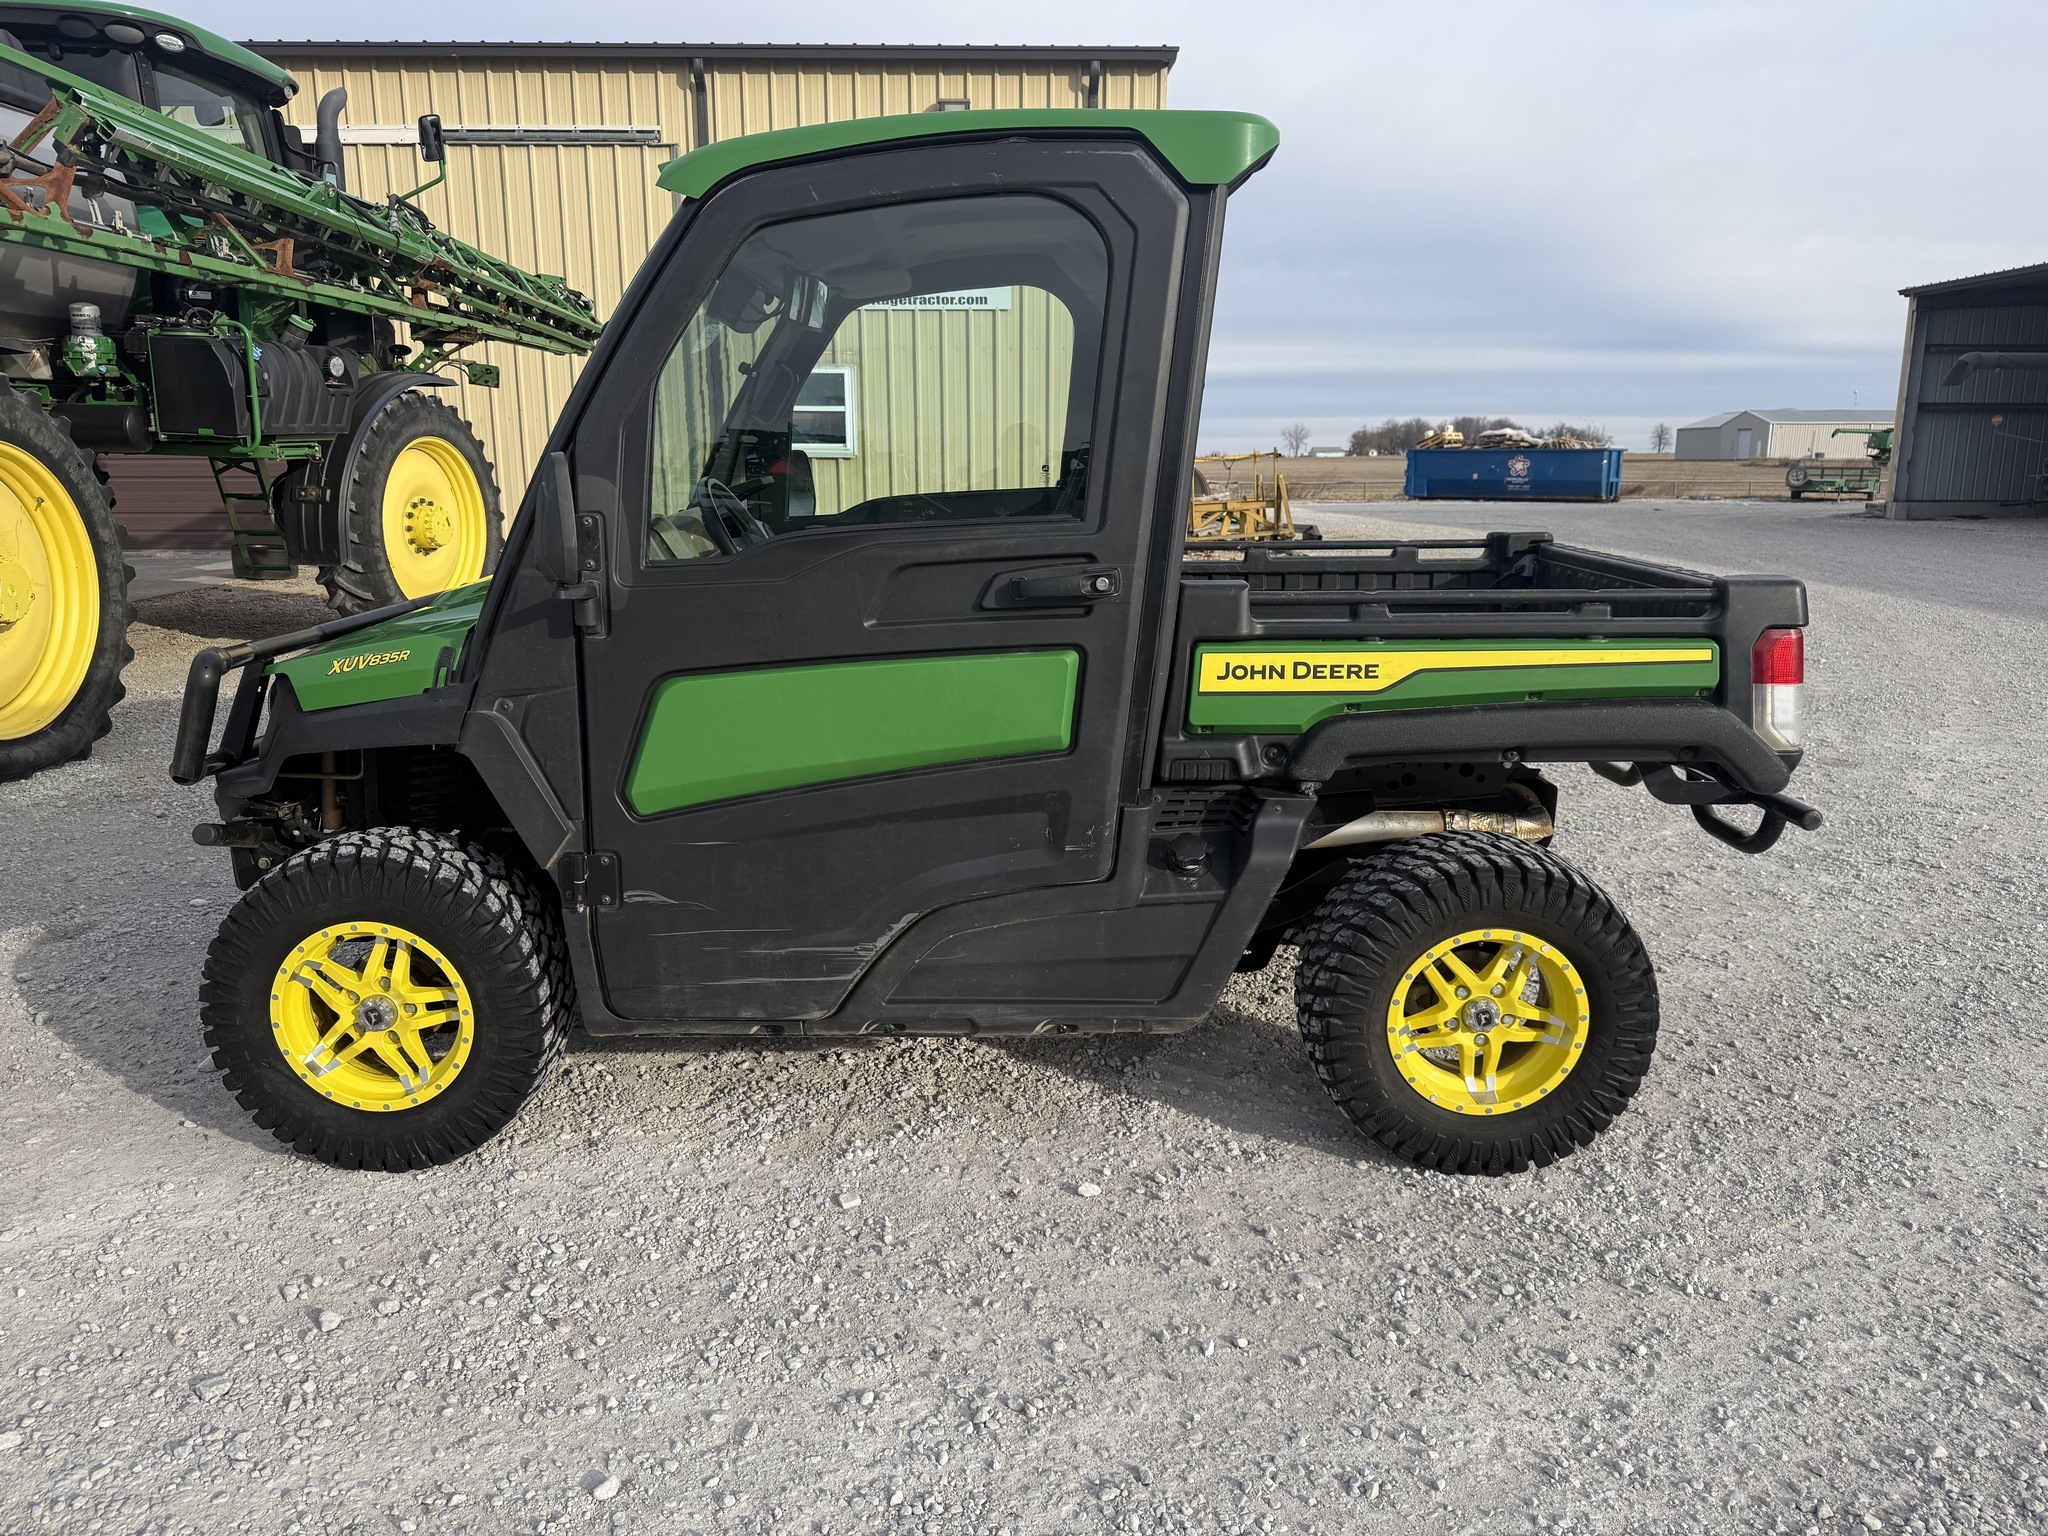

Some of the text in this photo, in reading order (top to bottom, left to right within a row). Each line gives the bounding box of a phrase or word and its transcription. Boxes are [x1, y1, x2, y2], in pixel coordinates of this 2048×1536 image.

[325, 649, 411, 676] XUV835R
[1216, 661, 1380, 680] JOHN DEERE
